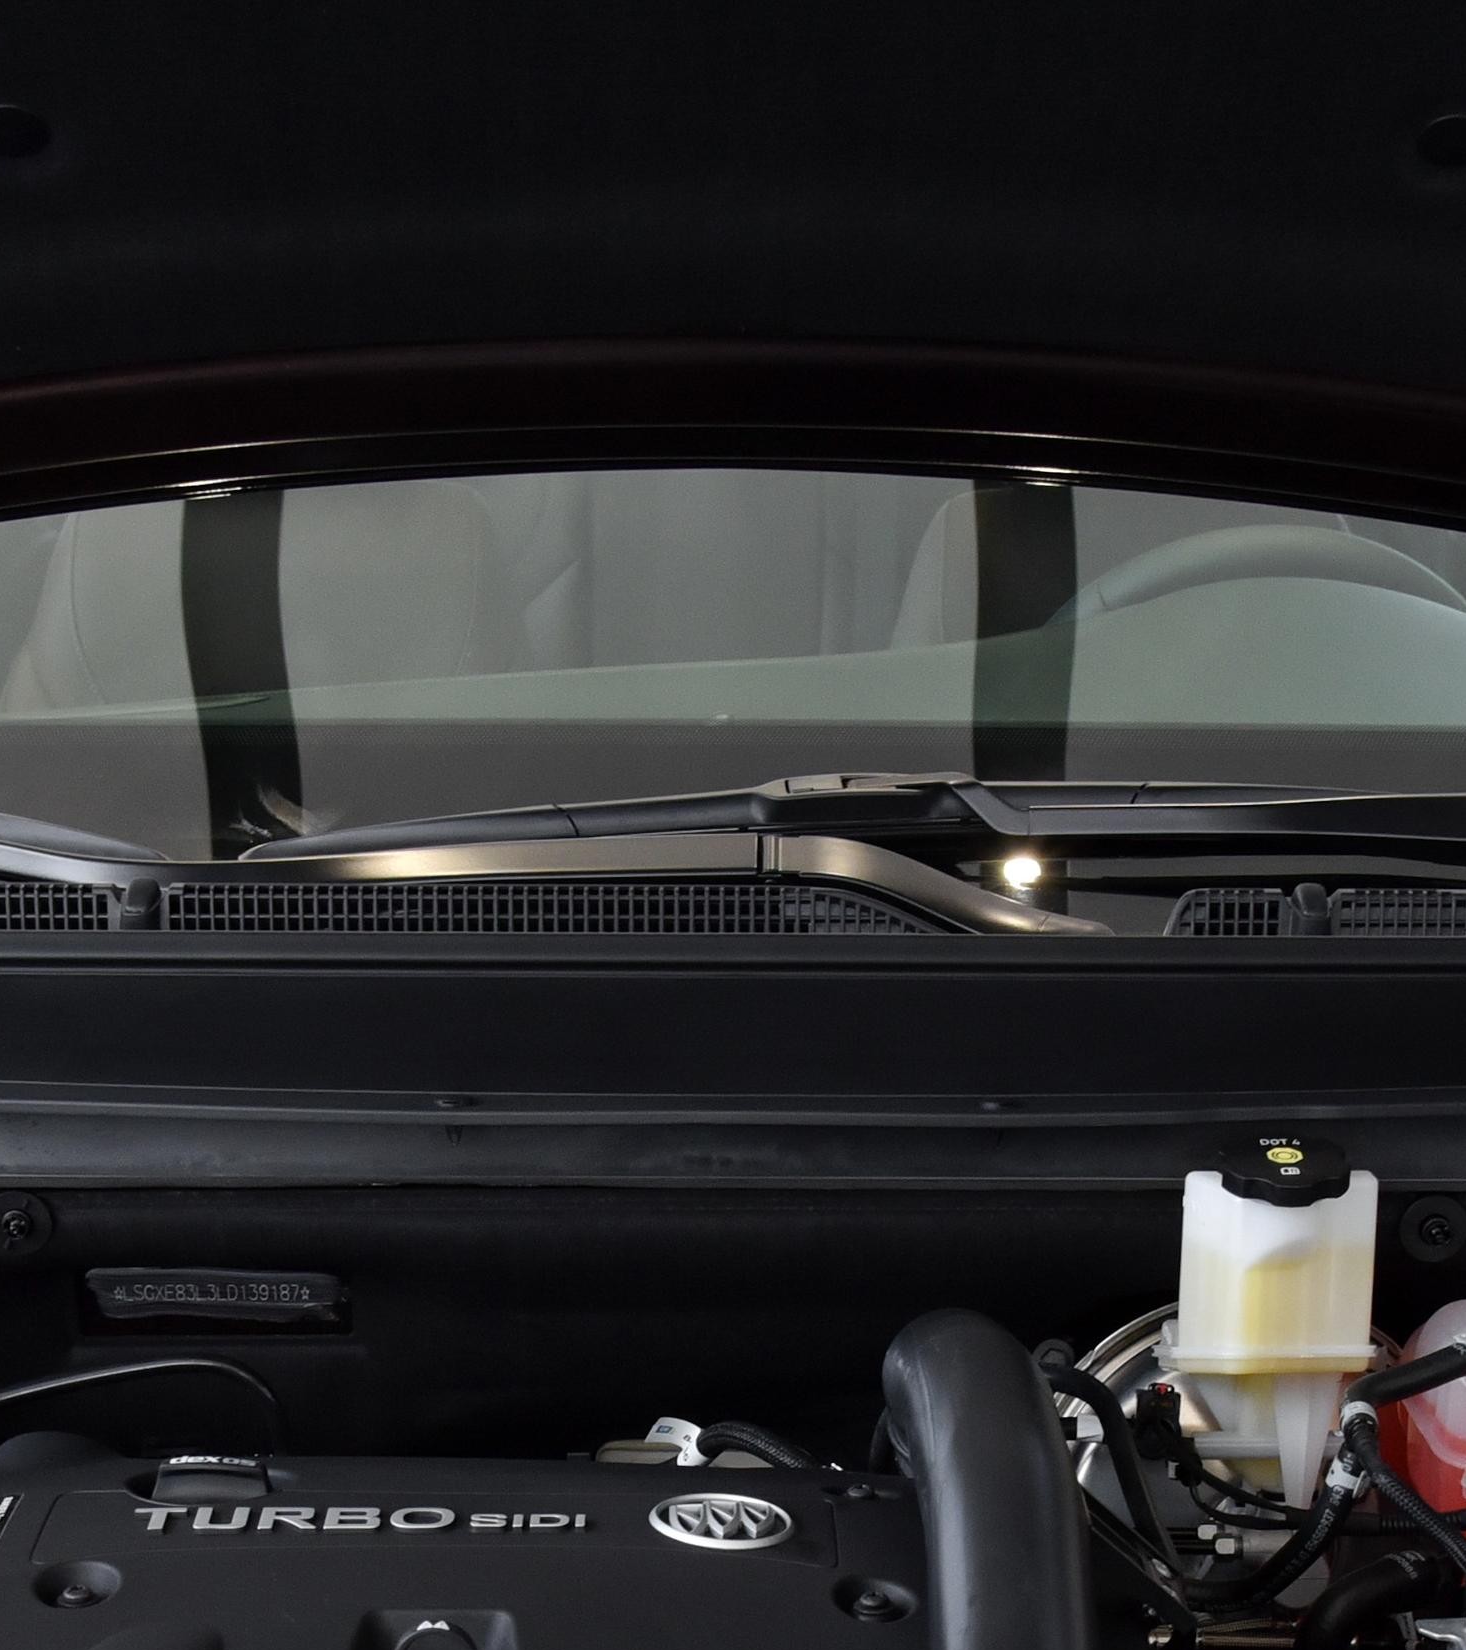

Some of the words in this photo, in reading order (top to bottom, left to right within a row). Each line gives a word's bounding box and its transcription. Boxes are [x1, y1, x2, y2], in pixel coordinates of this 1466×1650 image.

[1259, 1138, 1288, 1146] DOT
[1291, 1138, 1301, 1146] 4
[134, 1506, 456, 1531] TURBO
[469, 1512, 588, 1529] SIDI
